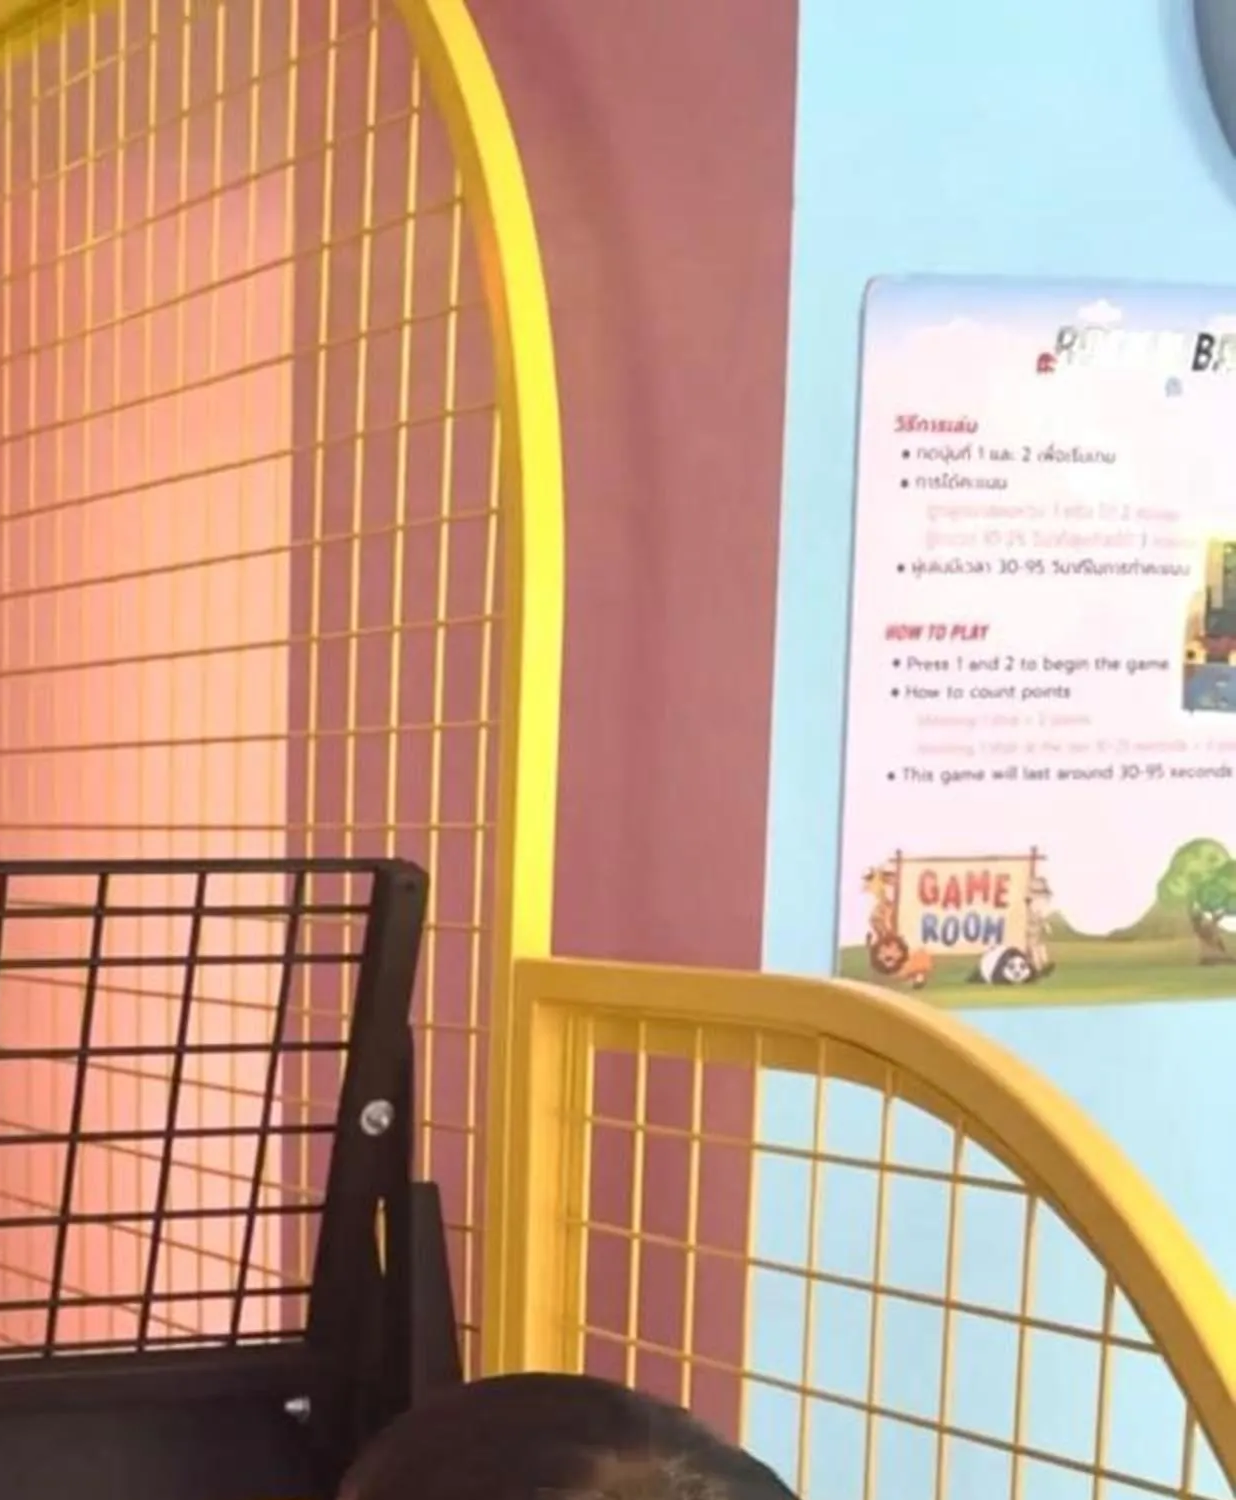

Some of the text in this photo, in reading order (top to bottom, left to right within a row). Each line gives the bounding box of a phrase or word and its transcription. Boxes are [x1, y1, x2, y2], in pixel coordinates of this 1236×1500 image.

[1021, 447, 1031, 462] 2
[999, 559, 1045, 576] 30-95
[885, 624, 990, 641] HOW TO PLAY
[907, 656, 949, 672] Press
[969, 657, 999, 672] and
[1004, 657, 1015, 672] 2
[1021, 657, 1037, 672] to
[1043, 656, 1089, 675] begin
[1094, 656, 1120, 672] the
[1126, 660, 1169, 675] game
[905, 684, 1071, 701] How to count points
[903, 763, 1233, 785] This game will last around 30-95 seconds
[917, 869, 1011, 910] GAME
[920, 912, 1006, 948] ROOM
